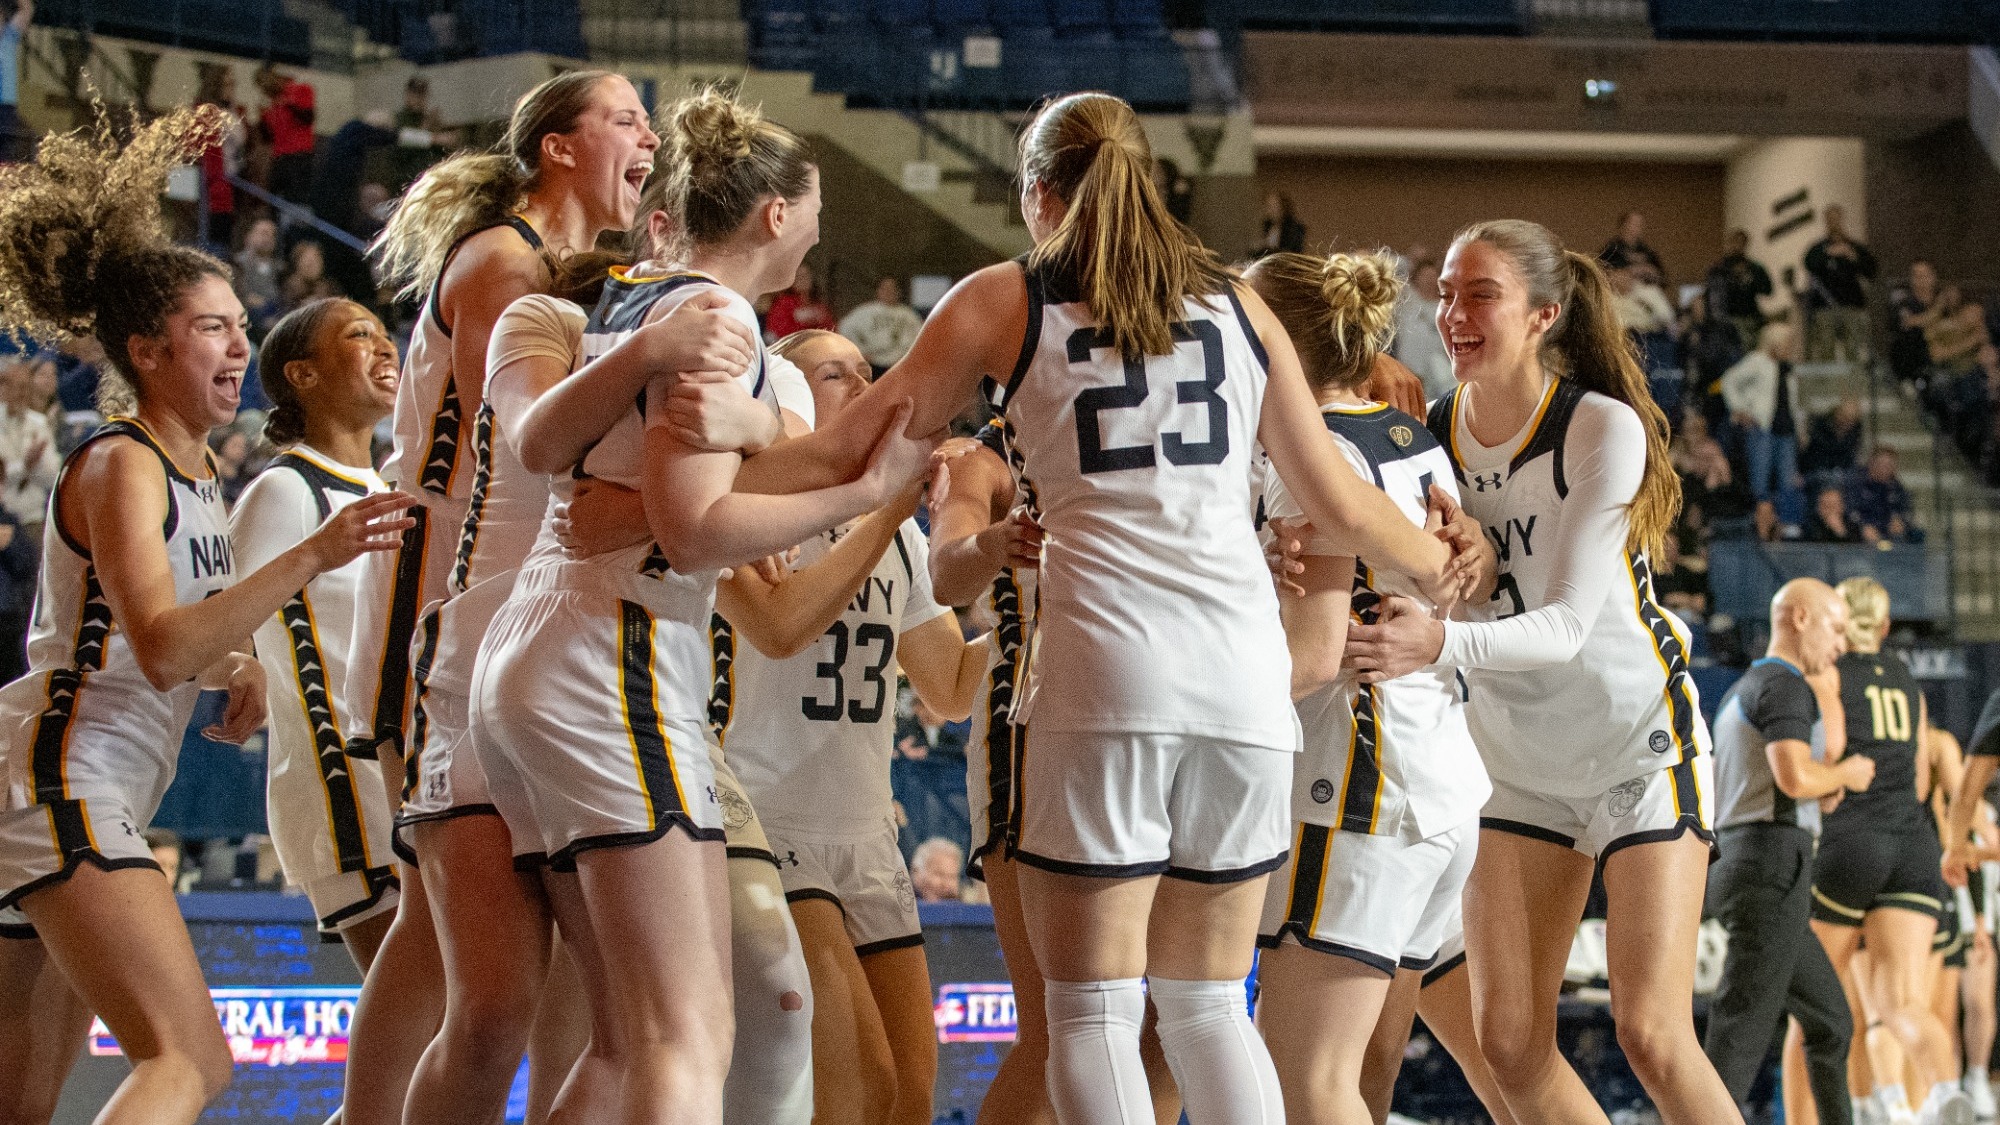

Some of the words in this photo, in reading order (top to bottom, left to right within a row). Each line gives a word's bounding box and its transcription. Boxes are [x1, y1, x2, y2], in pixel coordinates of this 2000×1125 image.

[1066, 319, 1229, 474] 23
[189, 534, 234, 579] NAV
[1488, 515, 1537, 561] VY
[848, 577, 893, 614] VY
[802, 620, 894, 723] 33
[1864, 685, 1911, 742] 10
[213, 1000, 296, 1037] RAL
